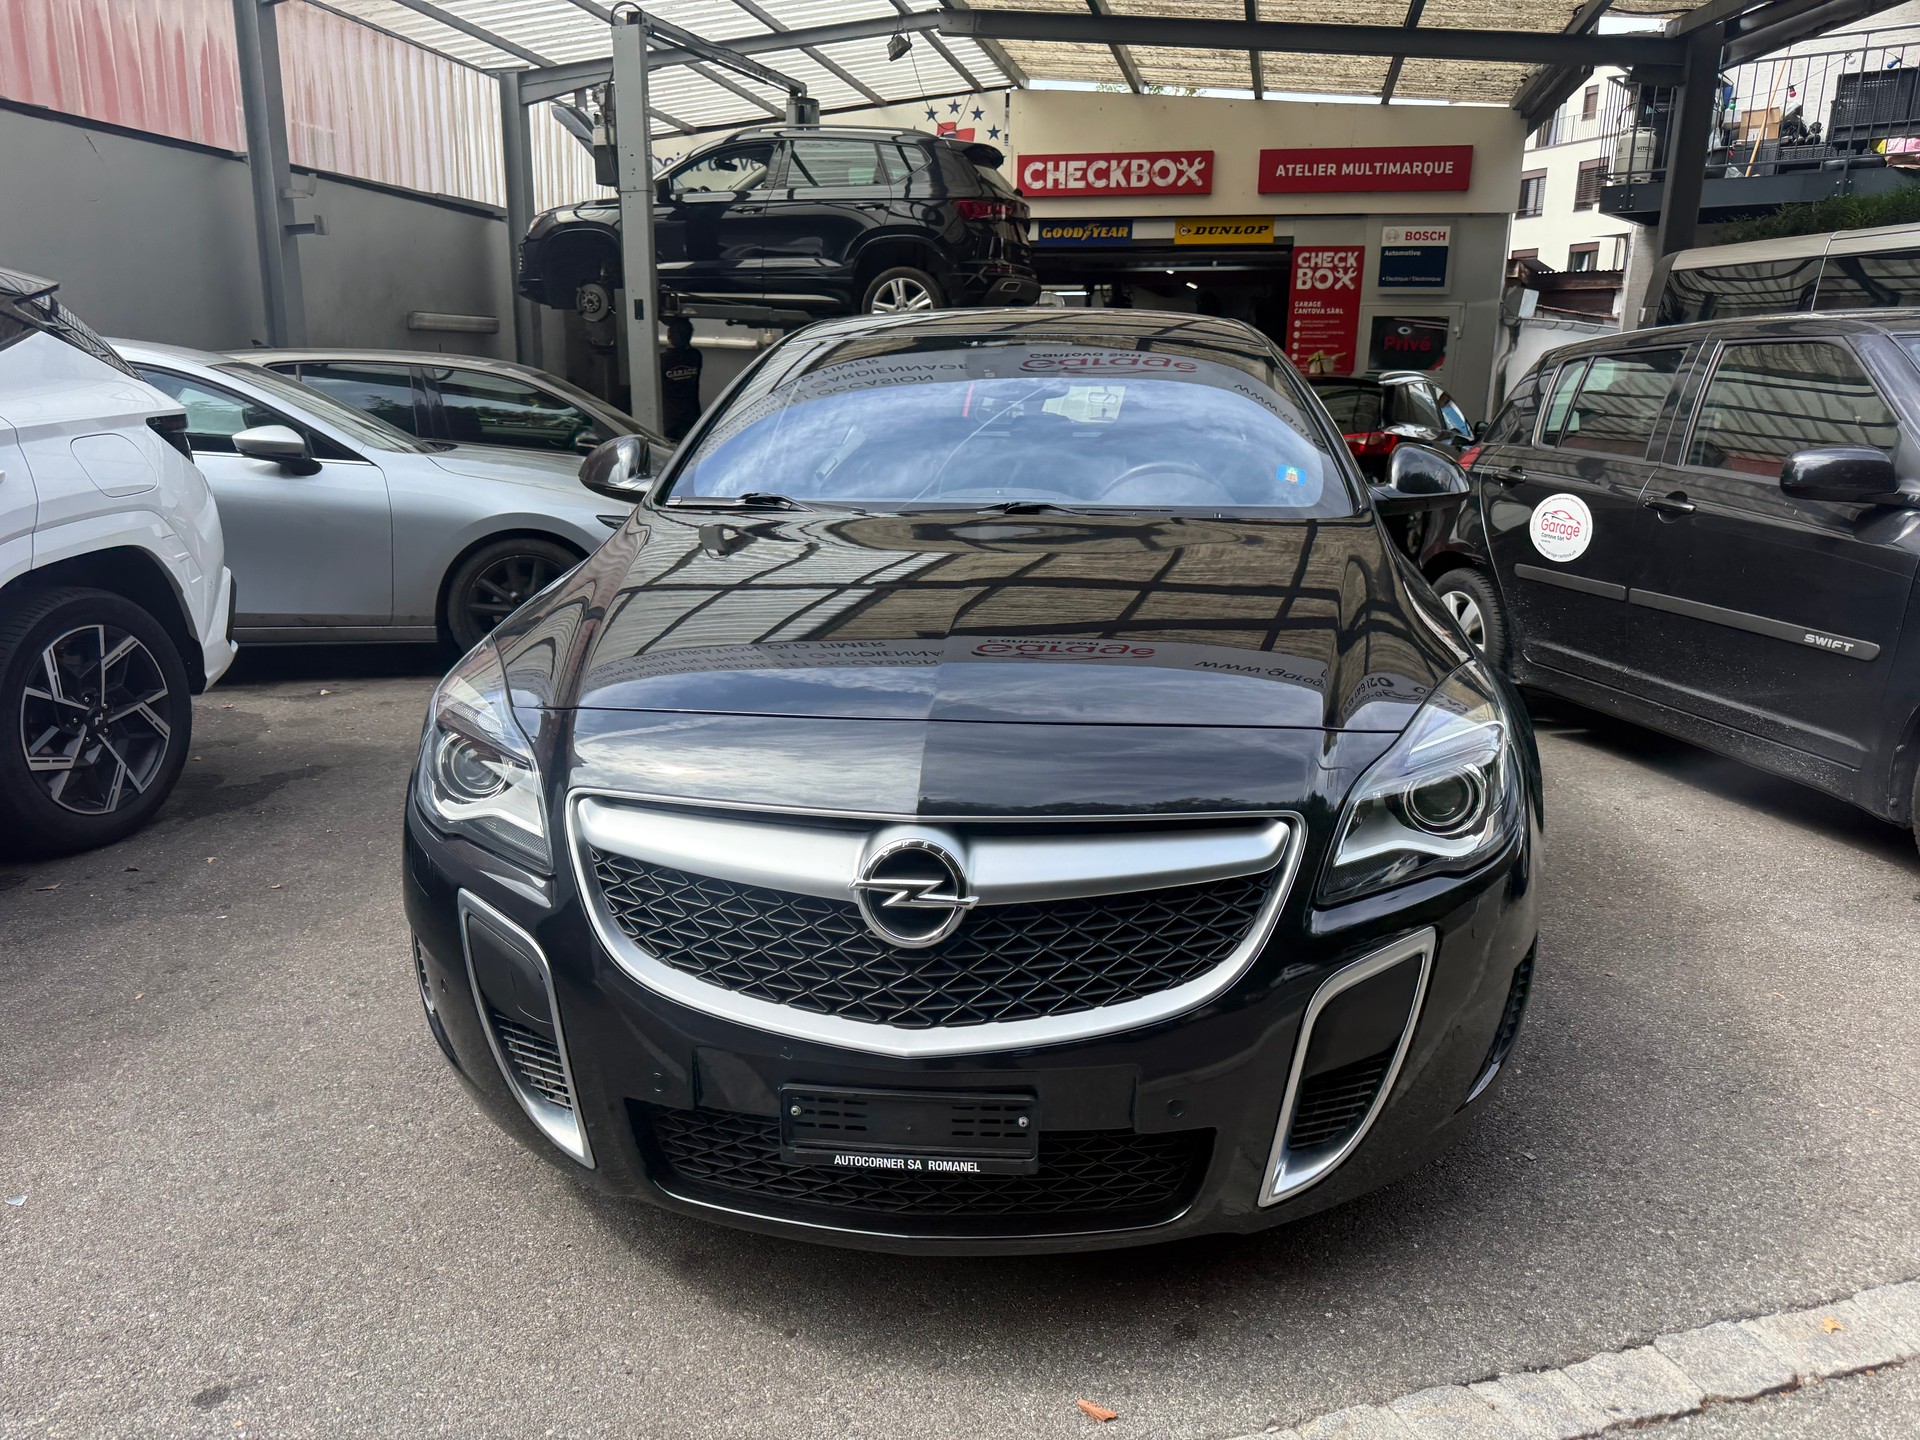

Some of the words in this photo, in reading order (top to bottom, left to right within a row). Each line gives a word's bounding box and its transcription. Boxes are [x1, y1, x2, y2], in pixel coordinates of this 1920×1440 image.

[1024, 157, 1206, 190] CHECKBOX
[1275, 163, 1337, 177] ATELIER
[1341, 161, 1454, 176] MULTIMARQUE
[1041, 224, 1129, 241] GOODYEAR
[1193, 225, 1270, 236] DUNLOP
[1404, 231, 1447, 241] BOSCH
[1297, 252, 1359, 268] CHECK
[1295, 268, 1358, 290] BOX
[1294, 307, 1325, 315] CANTOVA
[1383, 335, 1432, 352] Privé
[1541, 518, 1580, 541] Garage
[1804, 633, 1854, 652] SWIFT
[881, 840, 946, 858] OPEL
[834, 1155, 905, 1170] AUTOCORNER
[907, 1159, 922, 1170] SA
[928, 1160, 981, 1172] ROMANEL
